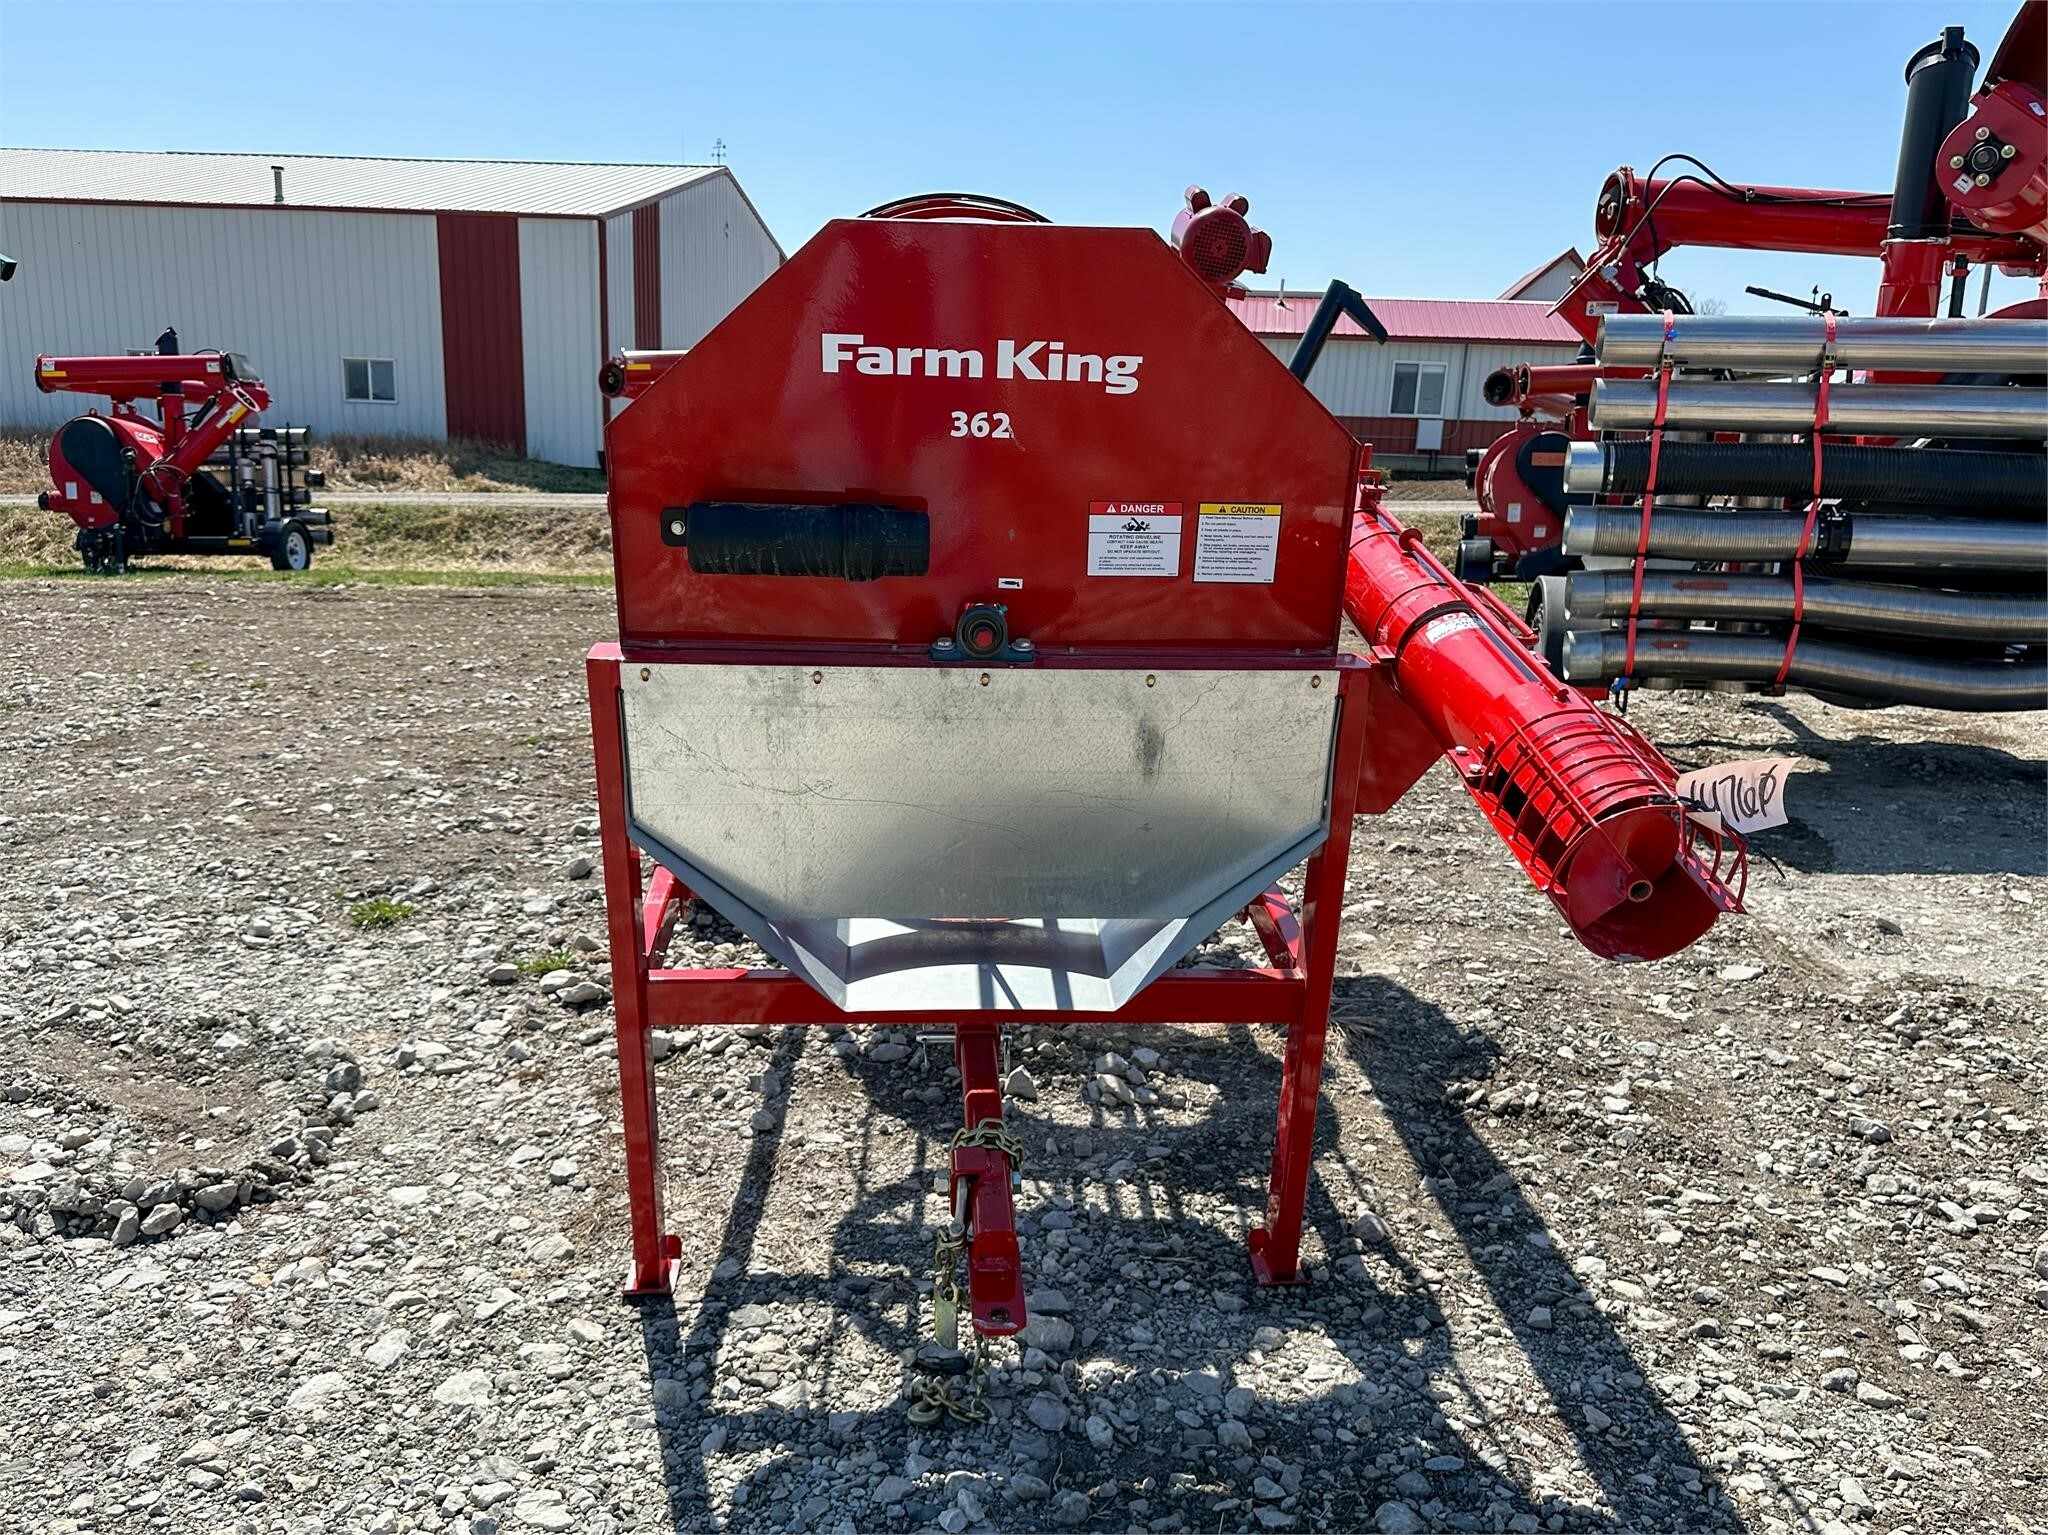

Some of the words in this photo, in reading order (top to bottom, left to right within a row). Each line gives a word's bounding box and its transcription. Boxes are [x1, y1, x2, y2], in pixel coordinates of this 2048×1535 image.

[822, 333, 984, 378] Farm
[996, 339, 1144, 395] King
[950, 410, 1011, 438] 362
[1120, 504, 1165, 513] DANGER
[1230, 506, 1266, 514] CAUTION
